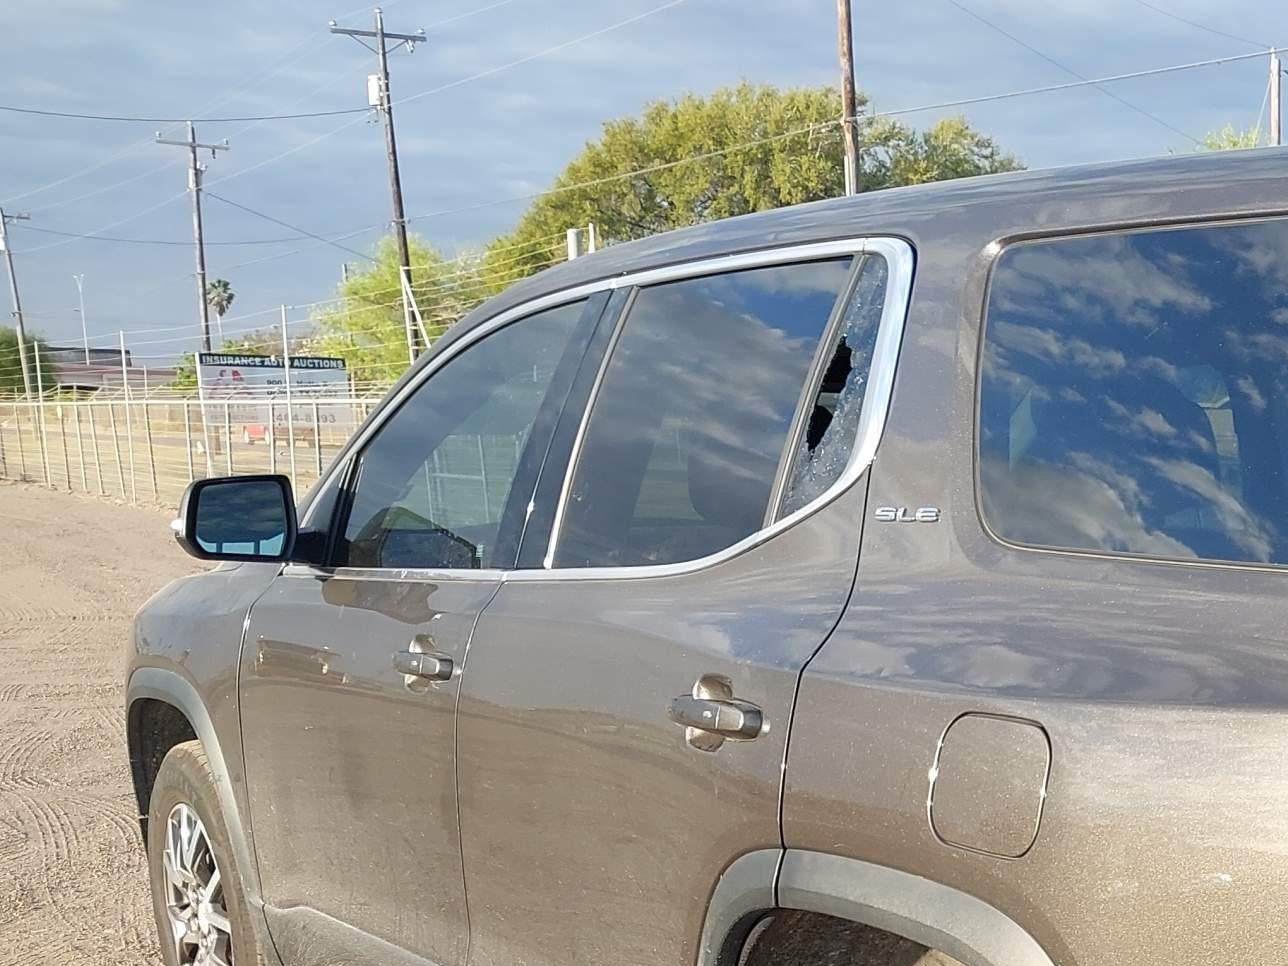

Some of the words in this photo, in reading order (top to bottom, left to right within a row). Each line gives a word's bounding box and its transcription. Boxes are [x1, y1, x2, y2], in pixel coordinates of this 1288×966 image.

[202, 355, 262, 366] INSURANCE
[293, 360, 344, 369] AUCTIONS
[874, 507, 941, 522] SLE
